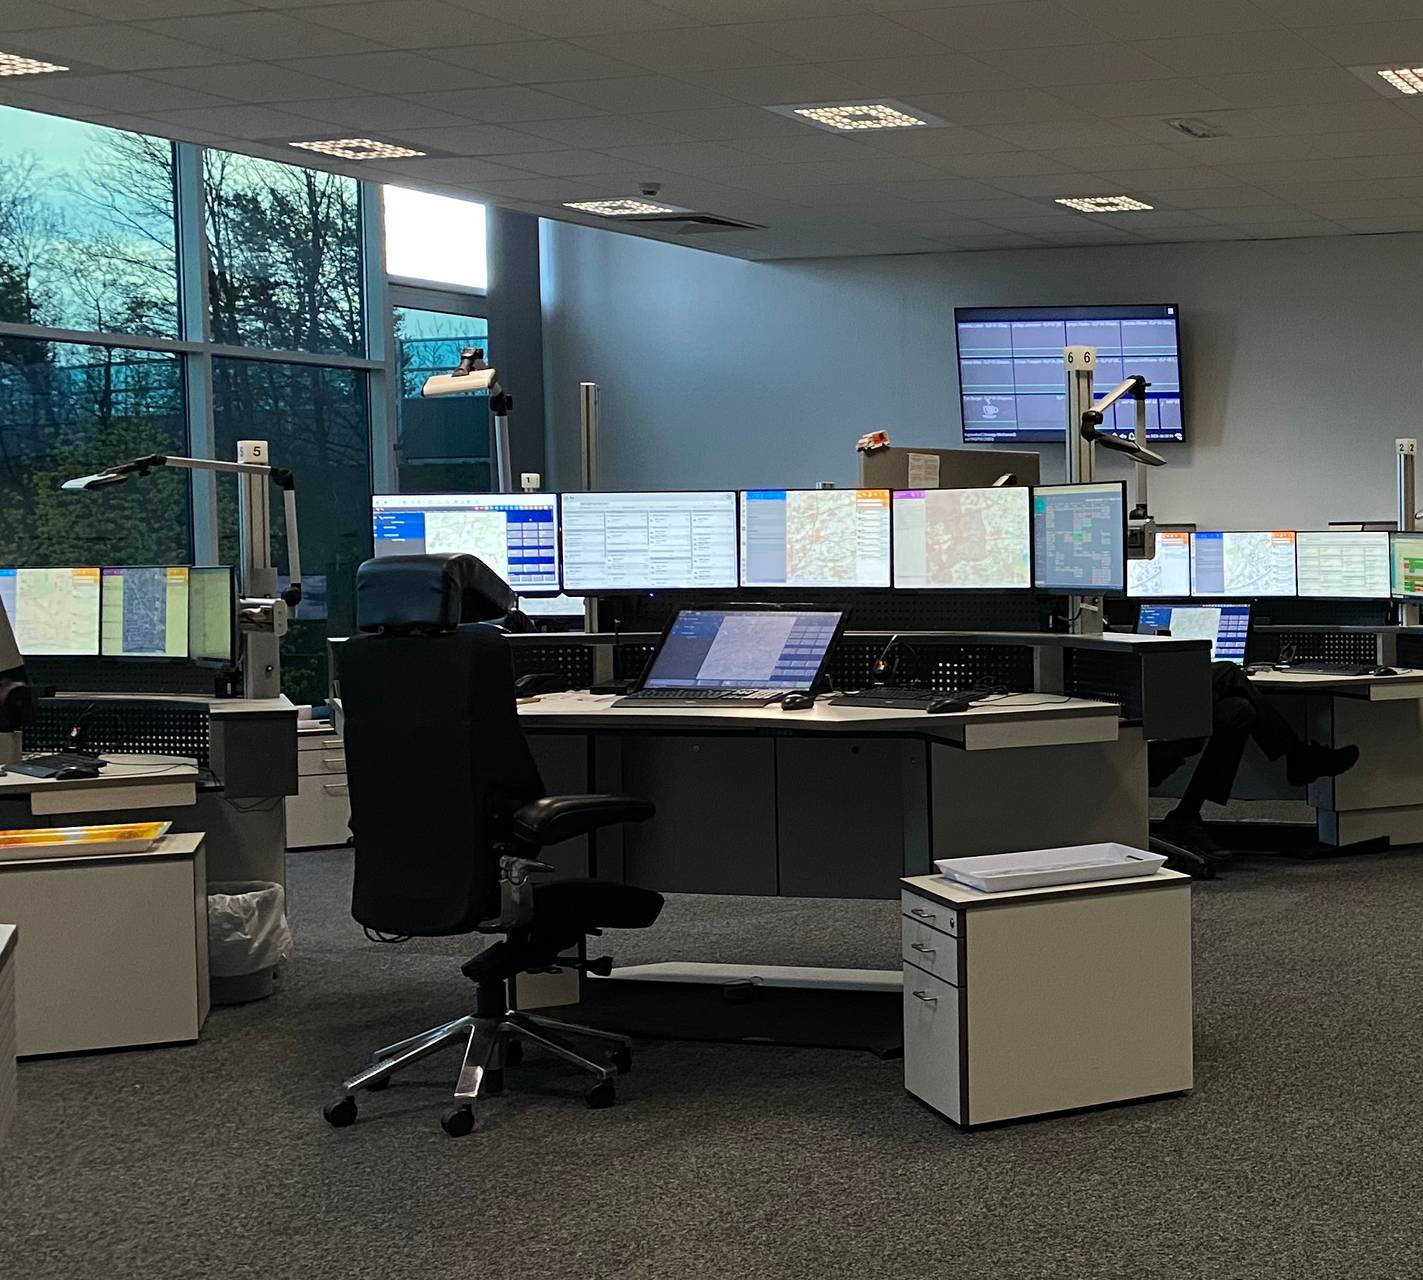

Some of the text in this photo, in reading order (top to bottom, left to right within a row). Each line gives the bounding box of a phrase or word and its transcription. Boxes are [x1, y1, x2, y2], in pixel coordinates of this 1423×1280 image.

[1067, 351, 1074, 363] 6
[1083, 351, 1091, 363] 6
[252, 446, 262, 457] 5
[1399, 443, 1404, 451] 2
[1409, 443, 1414, 451] 2
